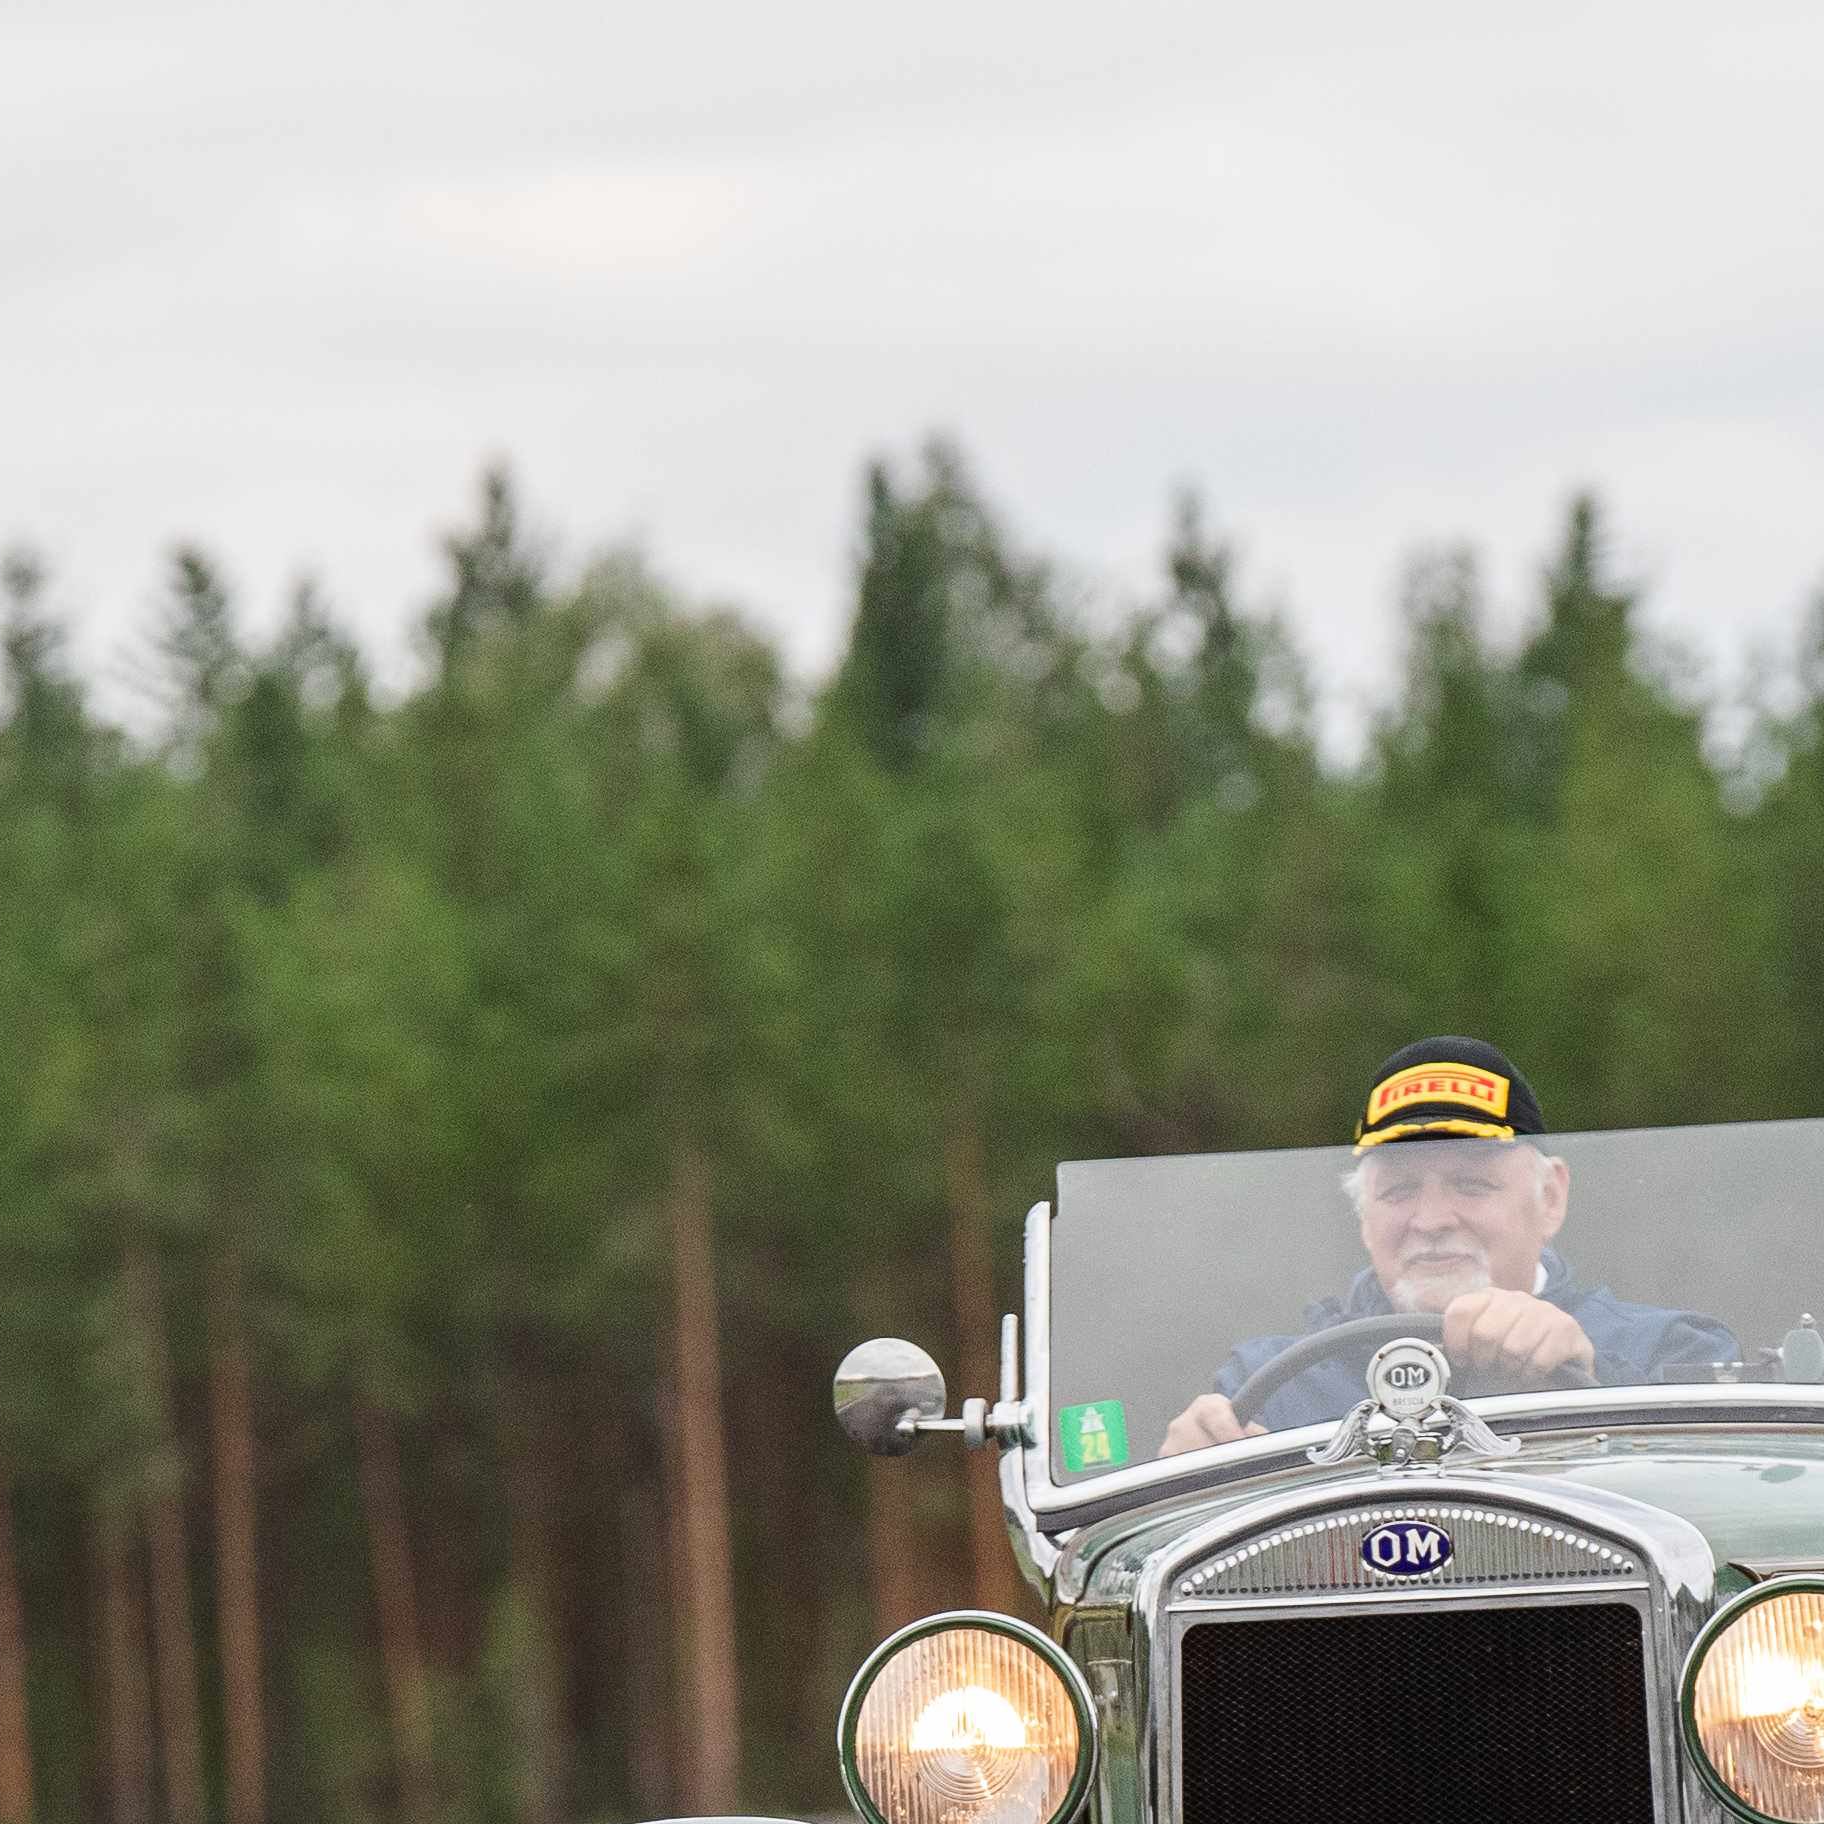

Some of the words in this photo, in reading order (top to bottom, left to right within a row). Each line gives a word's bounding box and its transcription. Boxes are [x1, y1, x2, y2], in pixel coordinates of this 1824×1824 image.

[1378, 1070, 1495, 1108] PIRELLI
[1390, 1366, 1425, 1388] OM
[1370, 1528, 1442, 1567] OM
